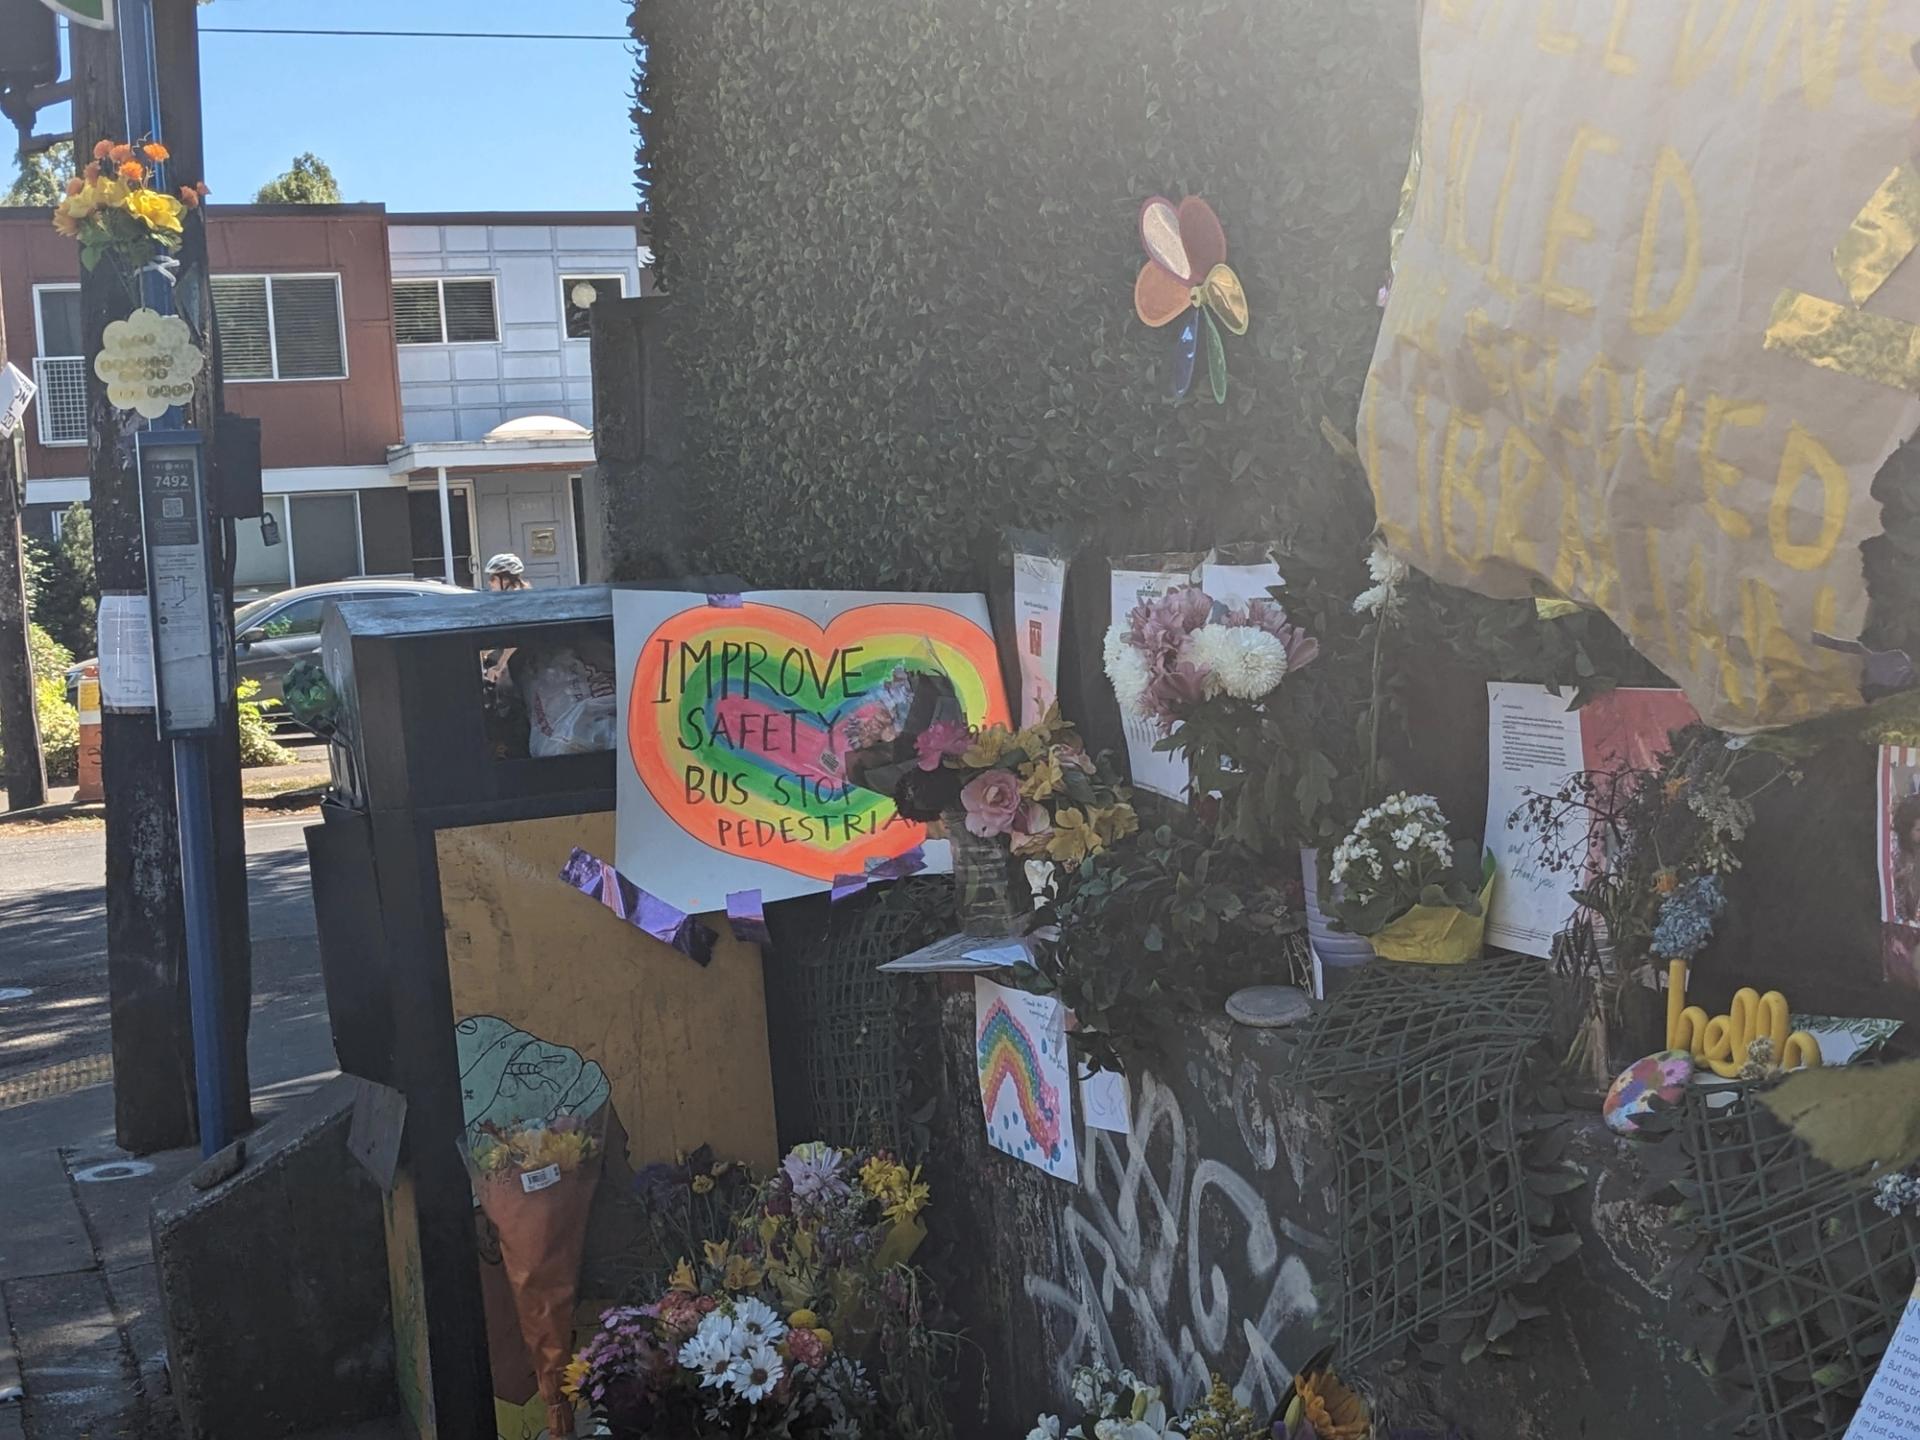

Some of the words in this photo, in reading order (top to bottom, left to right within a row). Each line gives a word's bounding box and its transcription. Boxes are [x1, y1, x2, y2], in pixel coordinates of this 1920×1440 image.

[153, 475, 189, 488] 7492
[651, 638, 867, 704] IMPROVE
[678, 706, 841, 754] SAFETY
[685, 764, 749, 805] BUS
[718, 810, 919, 848] PEDESTRIA
[1887, 1359, 1902, 1374] But
[1889, 1378, 1908, 1392] that
[1885, 1395, 1911, 1413] going
[1878, 1409, 1904, 1427] going
[1869, 1422, 1888, 1438] just
